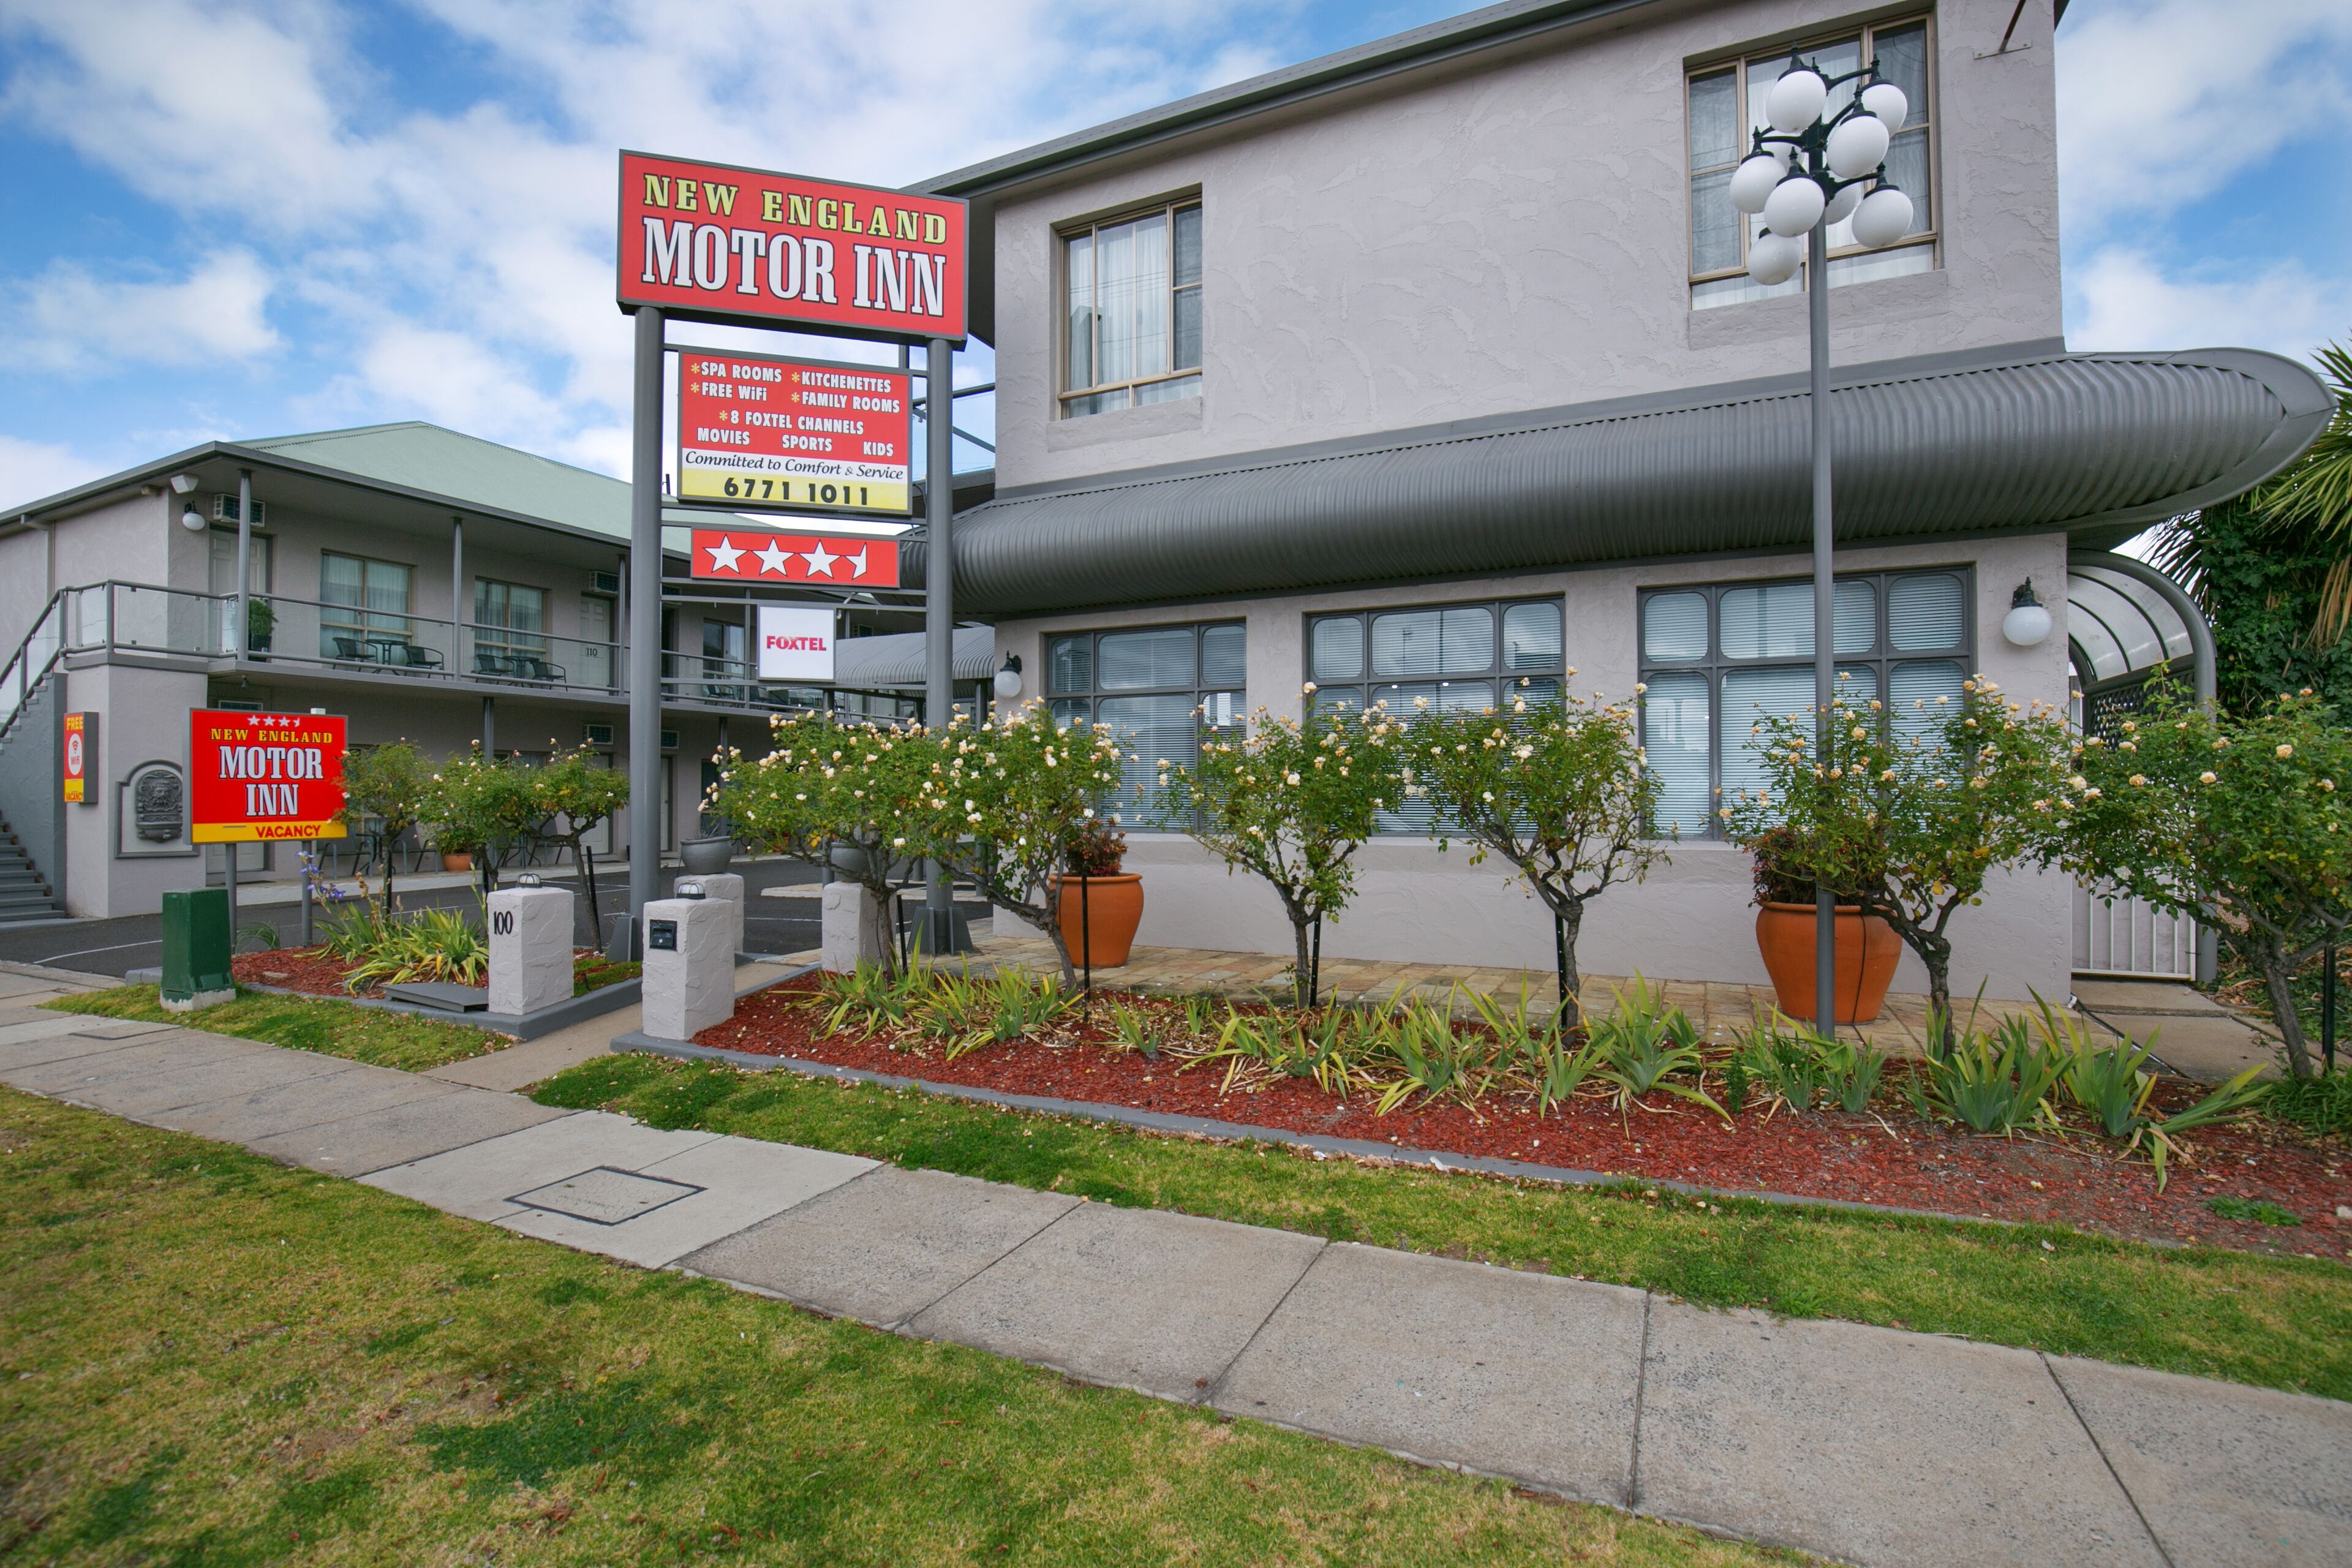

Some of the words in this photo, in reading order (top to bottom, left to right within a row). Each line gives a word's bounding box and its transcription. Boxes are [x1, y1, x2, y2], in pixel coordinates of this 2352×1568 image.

[643, 173, 739, 217] NEW
[761, 190, 947, 244] ENGLAND
[641, 216, 839, 304] MOTOR
[853, 244, 947, 317] INN
[701, 361, 726, 378] SPA
[732, 364, 782, 383] ROOMS
[801, 371, 891, 393] KITCHENETTES
[701, 382, 733, 398] FREE
[739, 385, 767, 401] WiFi
[802, 391, 848, 409] FAMILY
[853, 396, 900, 413] ROOMS
[730, 410, 739, 424] 8
[745, 412, 792, 429] FOXTEL
[798, 416, 864, 435] CHANNELS
[697, 427, 750, 445] MOVIES
[782, 435, 832, 452] SPORTS
[862, 442, 894, 457] KIDS
[685, 451, 763, 470] Committed
[767, 458, 781, 470] to
[785, 459, 842, 476] Comfort
[845, 466, 853, 476] &
[857, 464, 903, 480] Service
[724, 478, 790, 500] 6771
[809, 483, 868, 506] 1011
[587, 647, 598, 656] 110
[767, 636, 827, 651] FOXTEL
[67, 717, 83, 730] FREE
[211, 728, 249, 741] NEW
[258, 730, 333, 744] ENGLAND
[219, 745, 324, 780] MOTOR
[66, 792, 83, 801] VACANCY
[246, 783, 299, 816] INN
[255, 824, 321, 838] VACANCY
[493, 911, 513, 935] 100
